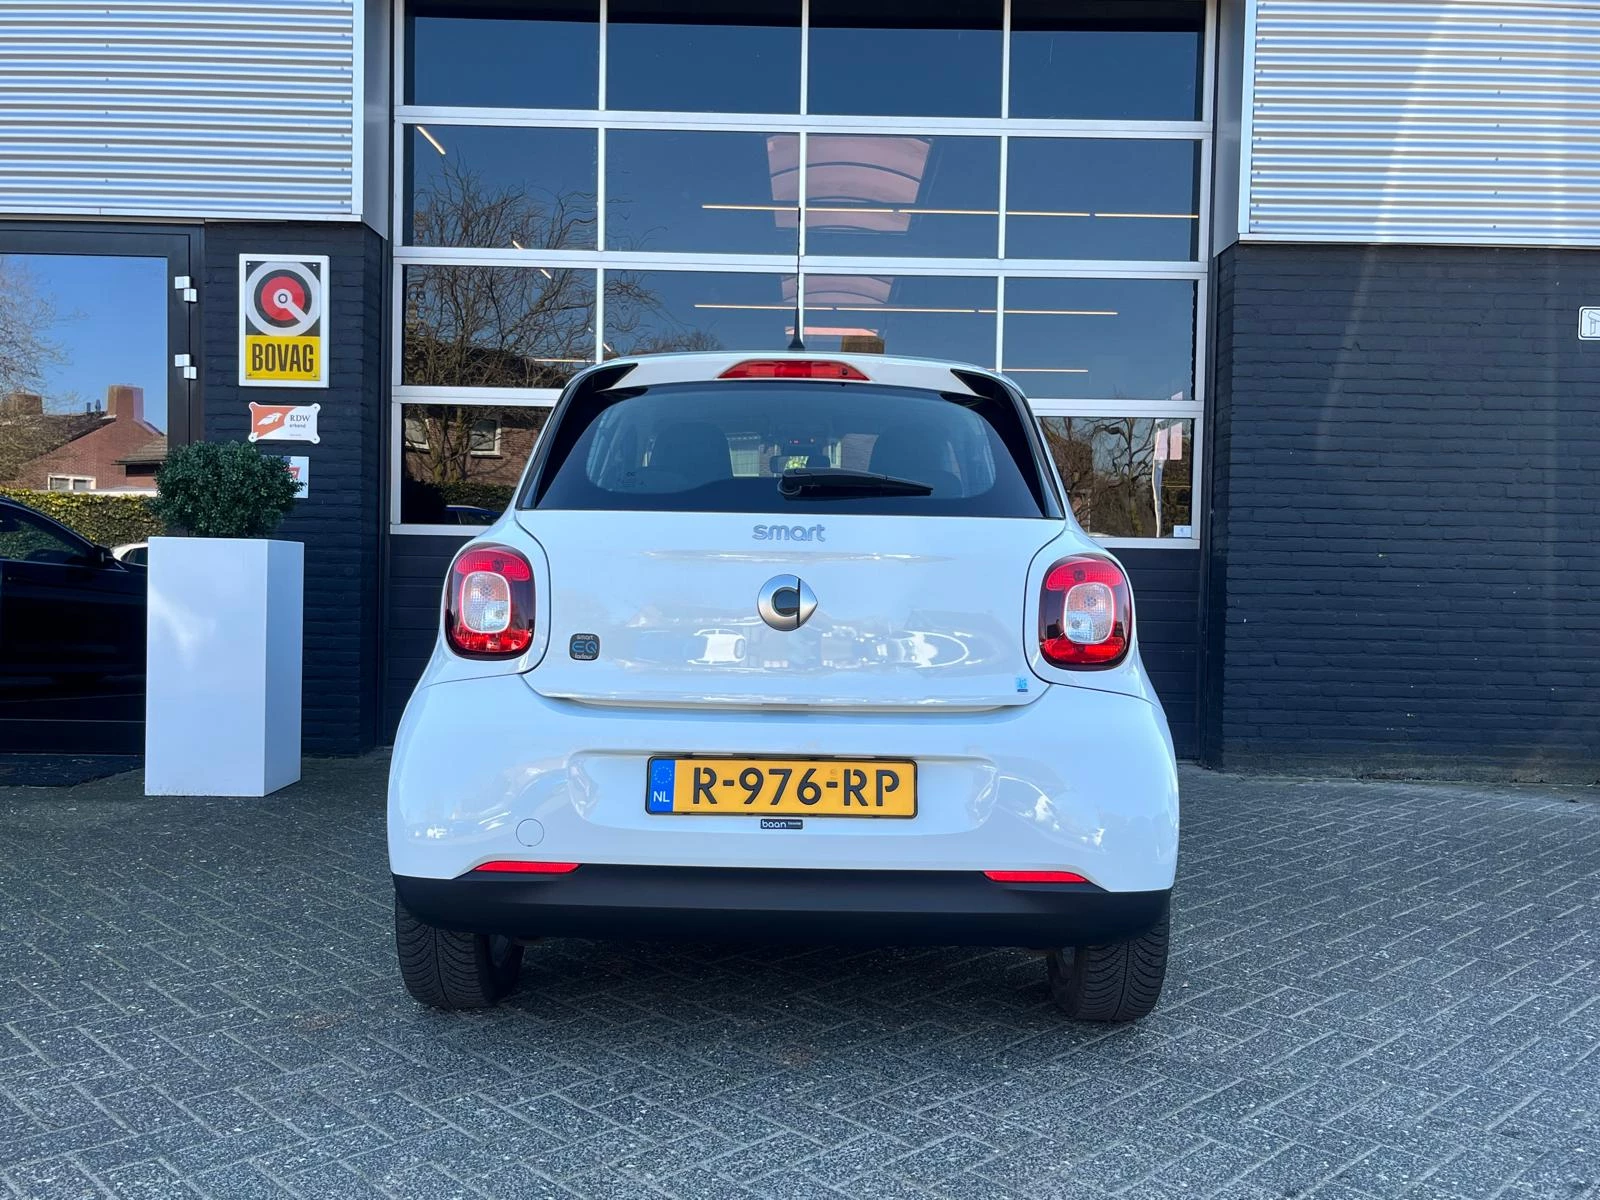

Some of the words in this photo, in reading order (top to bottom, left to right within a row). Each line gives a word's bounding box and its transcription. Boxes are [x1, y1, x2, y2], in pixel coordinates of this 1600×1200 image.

[251, 343, 314, 373] BOVAG
[752, 524, 825, 542] smart
[572, 641, 597, 653] EQ
[692, 767, 900, 807] R-976-RP
[653, 790, 671, 803] NL
